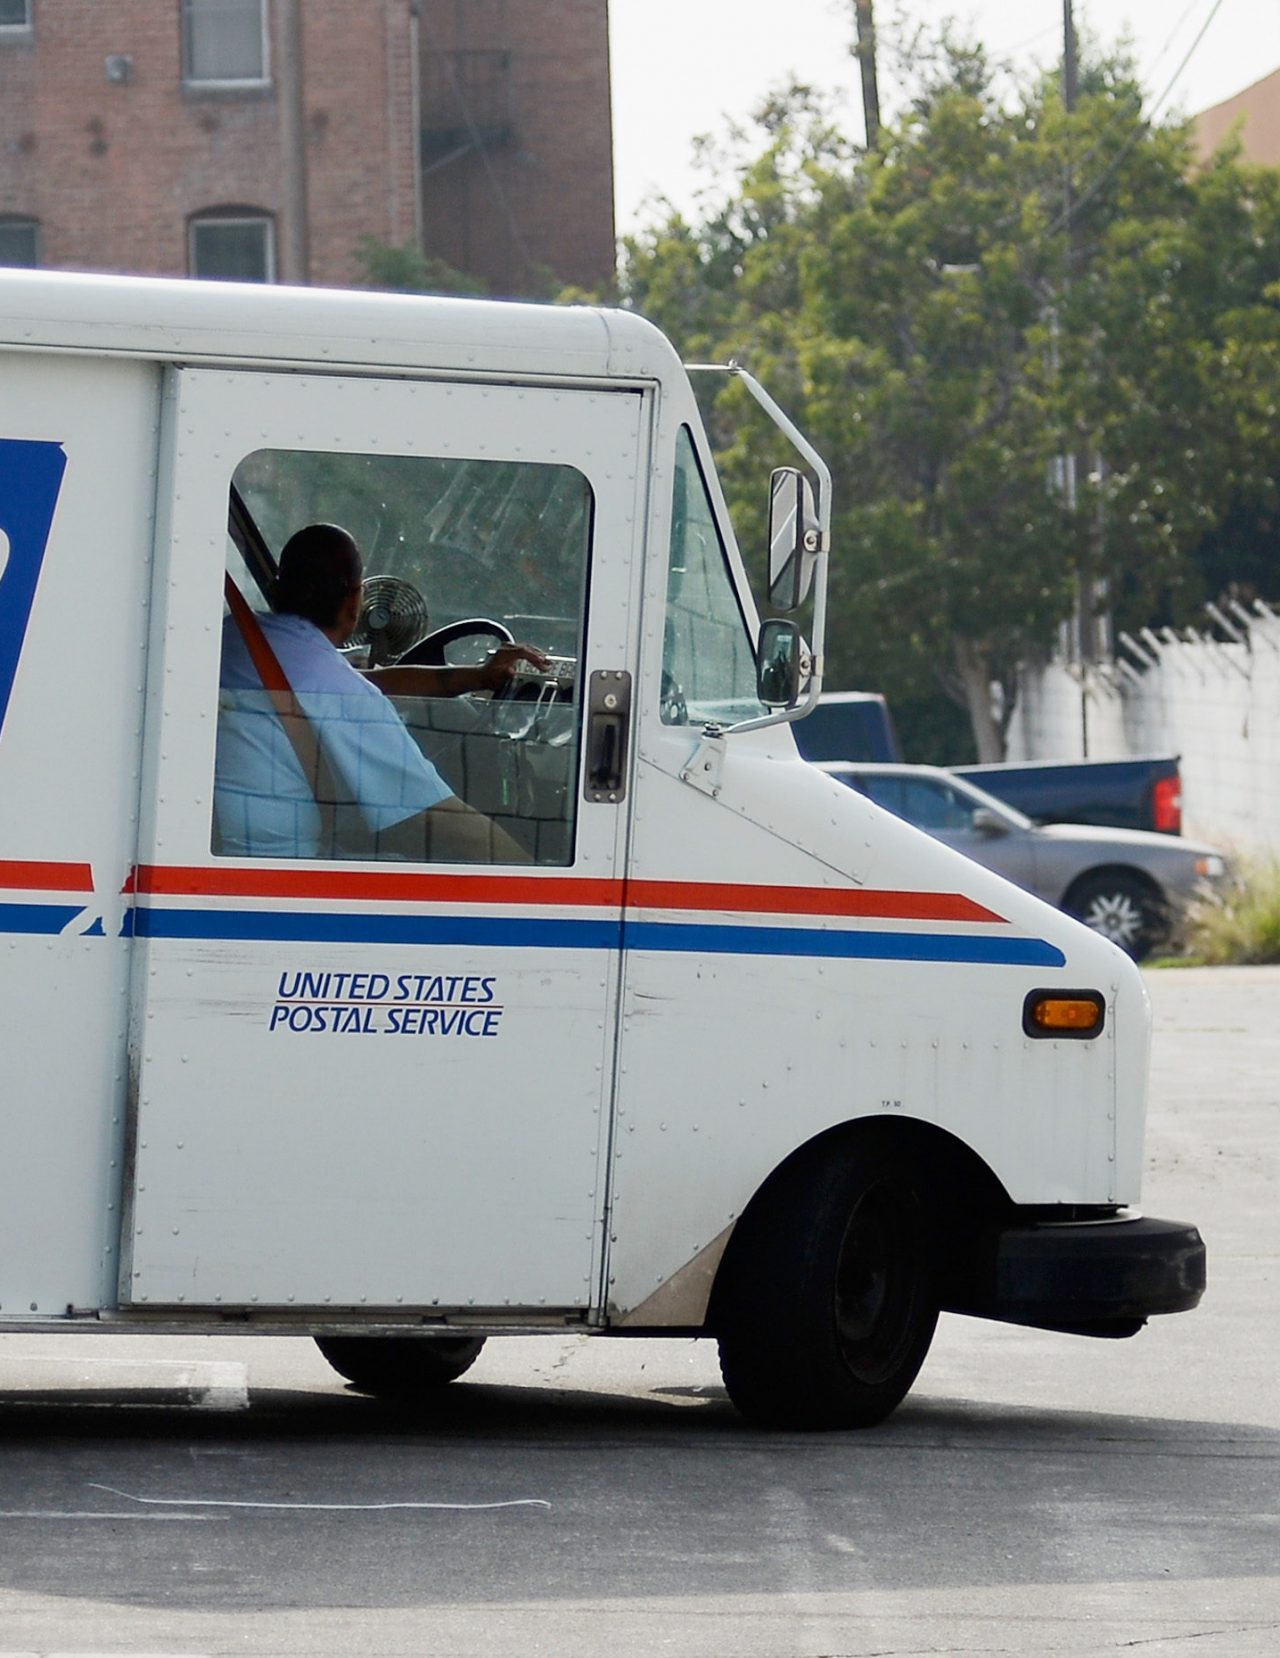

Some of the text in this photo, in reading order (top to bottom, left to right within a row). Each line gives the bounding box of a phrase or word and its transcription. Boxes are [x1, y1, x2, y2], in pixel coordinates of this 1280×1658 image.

[278, 972, 497, 1003] UNITED STATES
[269, 1005, 503, 1036] POSTAL SERVICE
